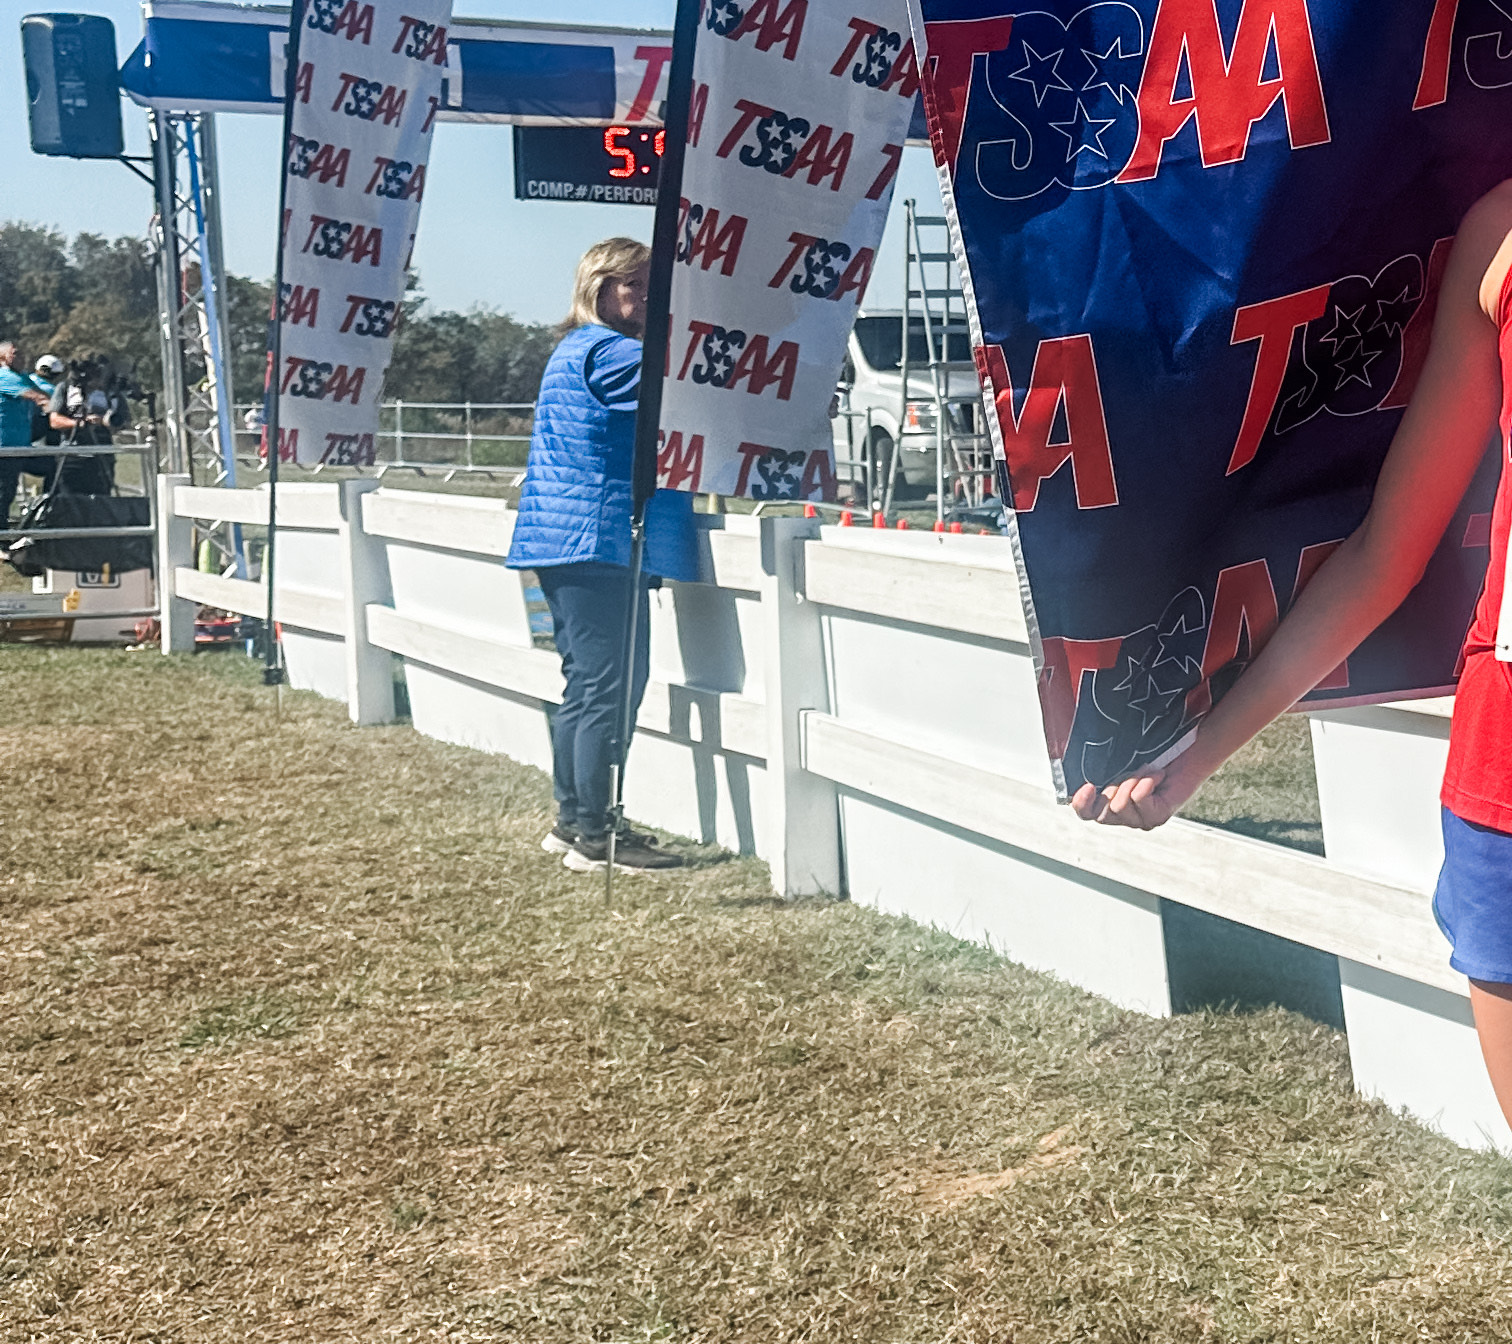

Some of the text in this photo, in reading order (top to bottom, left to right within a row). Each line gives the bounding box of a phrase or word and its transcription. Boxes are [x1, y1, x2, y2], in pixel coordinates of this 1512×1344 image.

[715, 98, 855, 193] TSSAA
[527, 179, 658, 204] COMP.#/PERFOR
[302, 214, 383, 267] TSSAA
[279, 356, 367, 405] TSSAA
[677, 320, 799, 401] TSSAA
